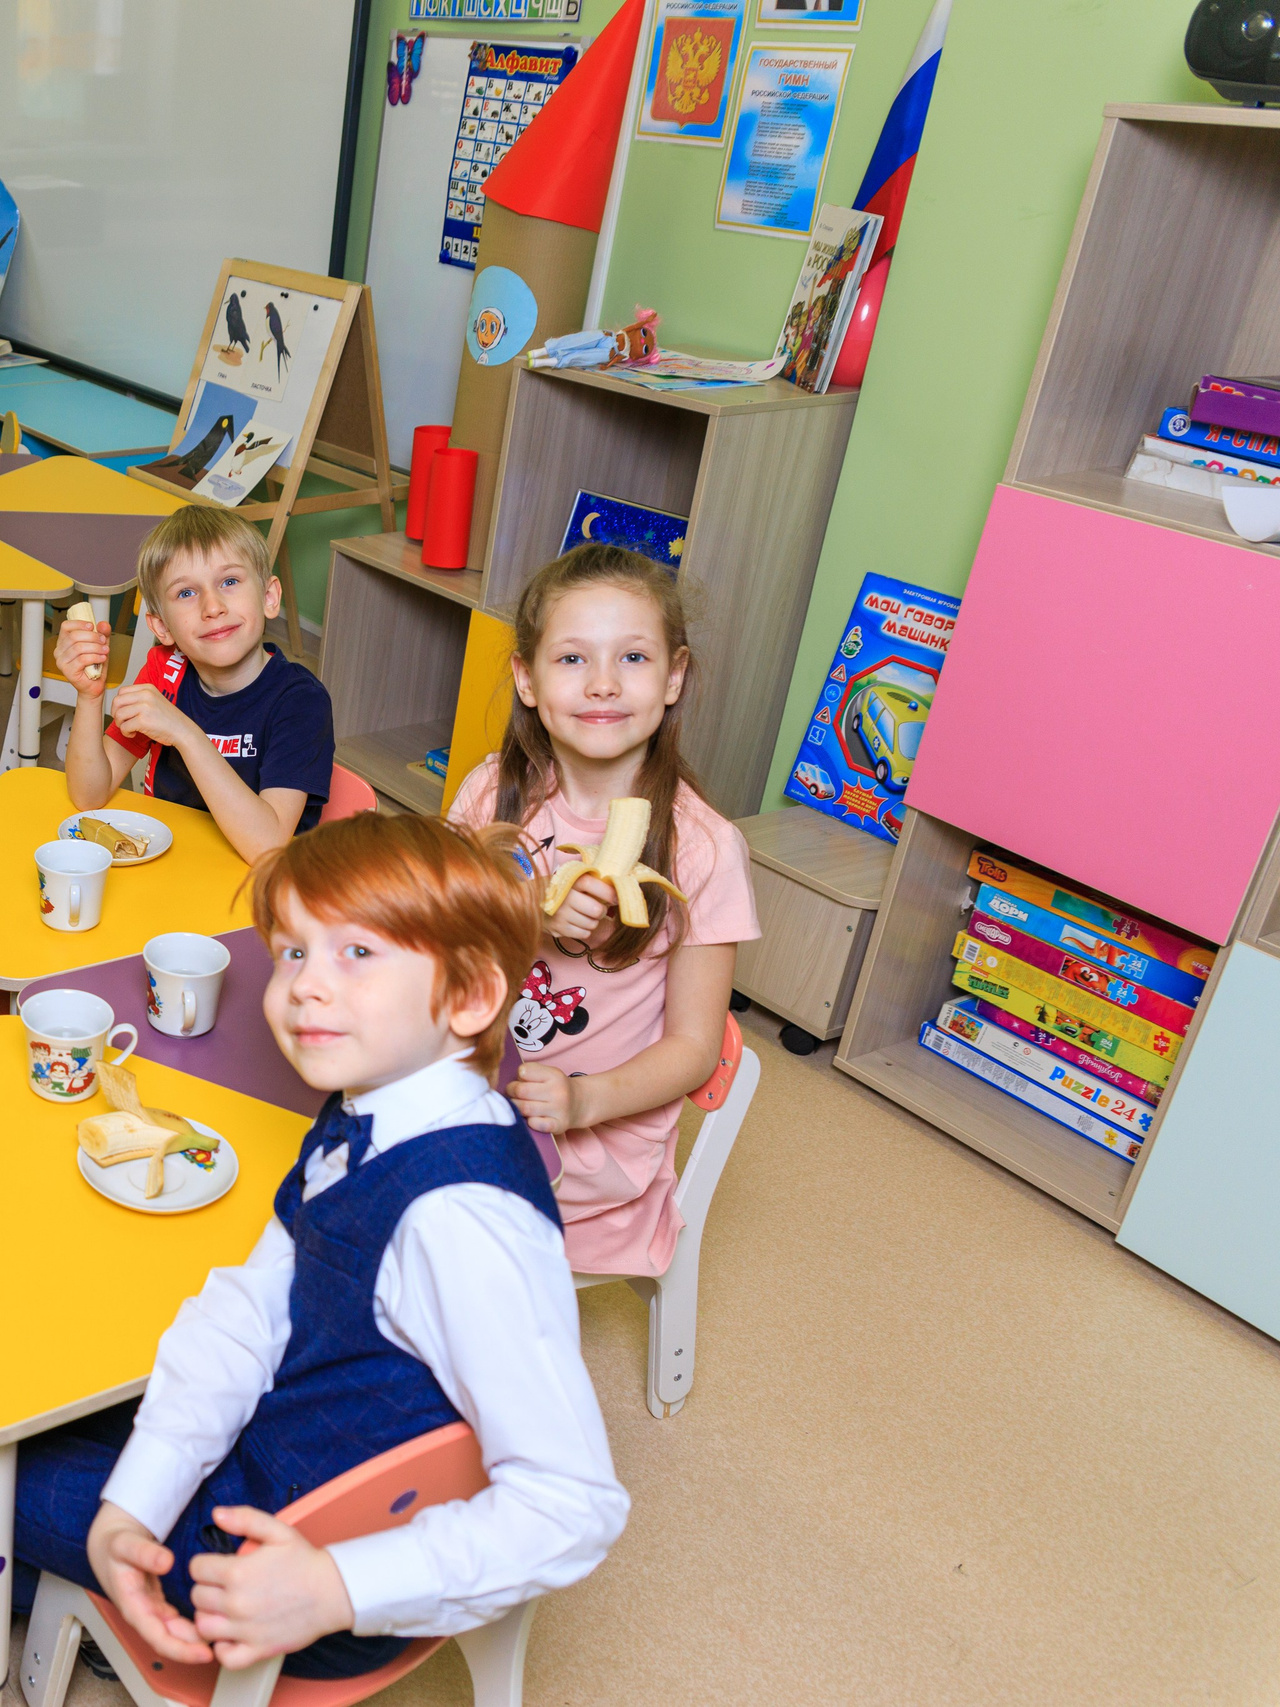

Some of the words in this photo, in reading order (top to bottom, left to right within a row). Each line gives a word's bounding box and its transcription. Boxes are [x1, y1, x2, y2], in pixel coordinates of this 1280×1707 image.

[486, 47, 562, 75] Алфавит
[758, 58, 838, 70] ГОСУДАРСТВЕННЫЙ
[777, 73, 810, 86] ГИМН
[751, 89, 791, 98] РОССИЙСКОЙ
[791, 92, 829, 100] ФЕДЕРАЦИИ
[904, 607, 956, 632] ГОВОР
[882, 620, 951, 652] МАШИНК
[163, 648, 187, 683] LIK
[221, 738, 239, 754] ME
[988, 899, 1028, 922] ДОРИ
[1048, 1066, 1110, 1108] Puzzle
[1110, 1100, 1137, 1122] 24
